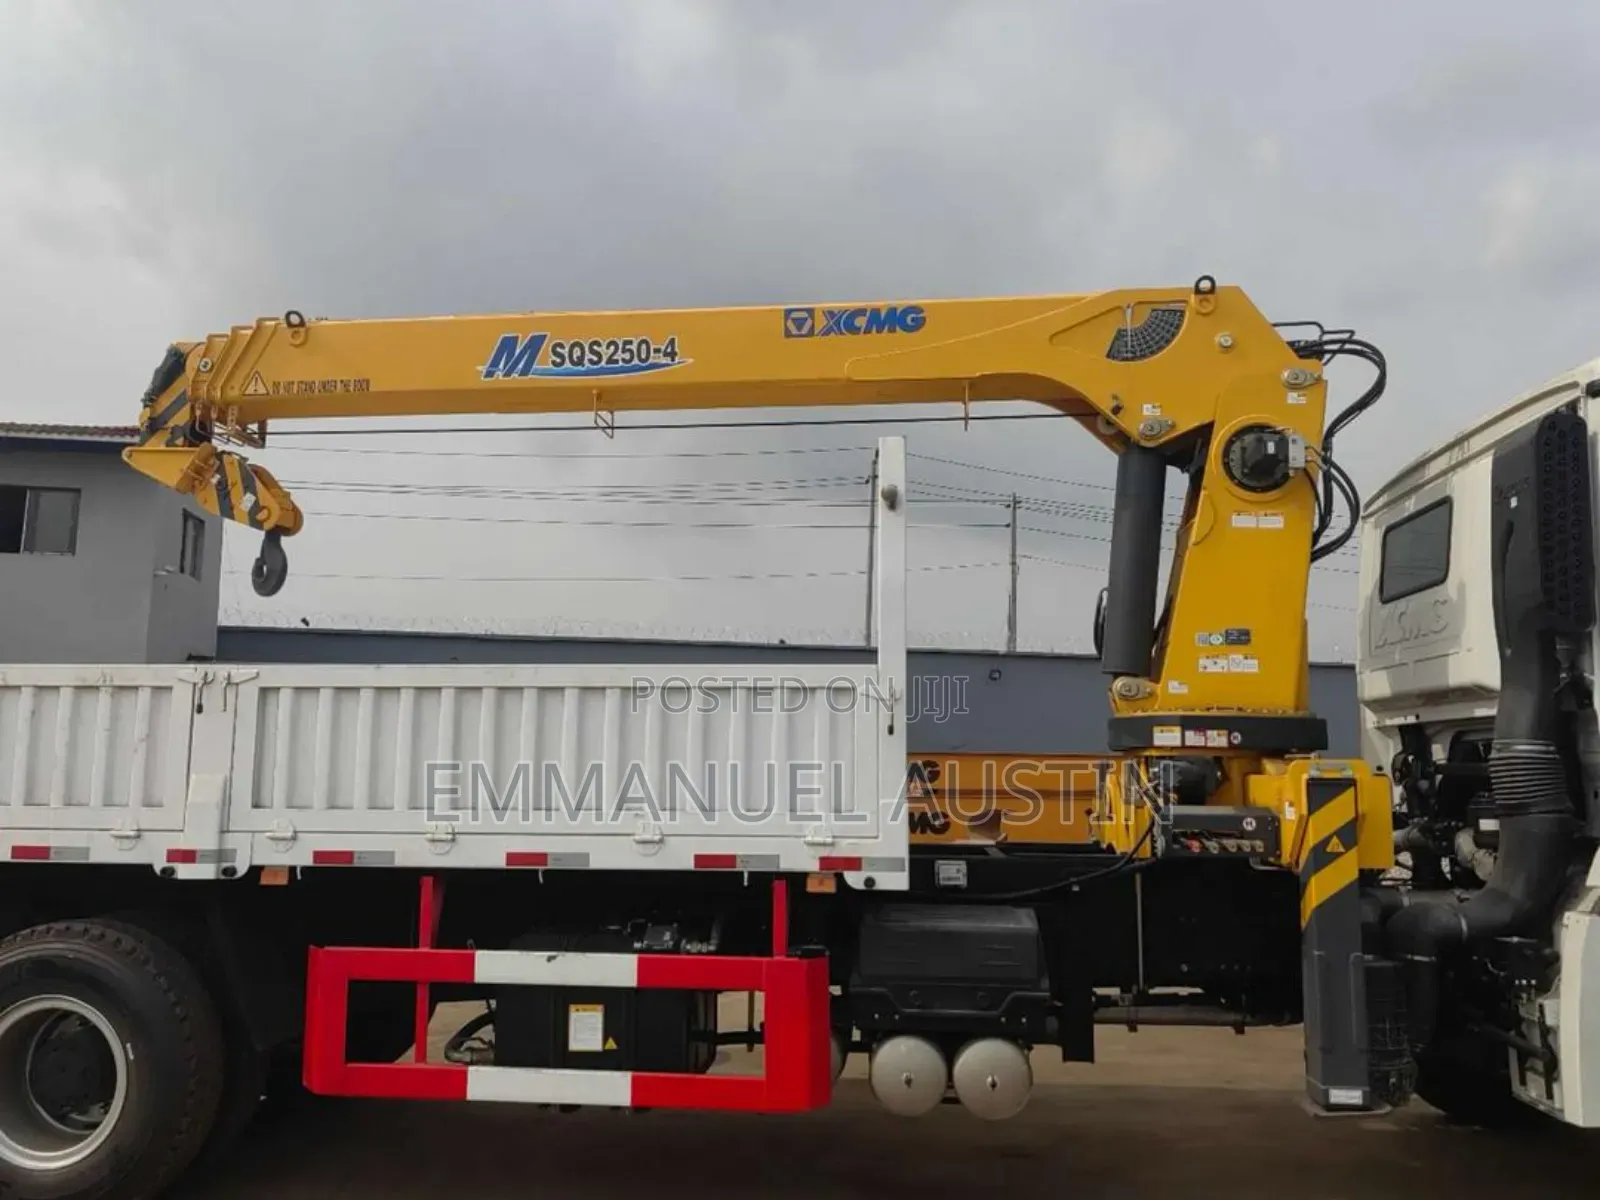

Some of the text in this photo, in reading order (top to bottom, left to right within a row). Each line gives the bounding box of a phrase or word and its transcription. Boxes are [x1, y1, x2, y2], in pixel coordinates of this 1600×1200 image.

[817, 305, 927, 336] XCMG
[482, 333, 679, 379] M SQS250-4
